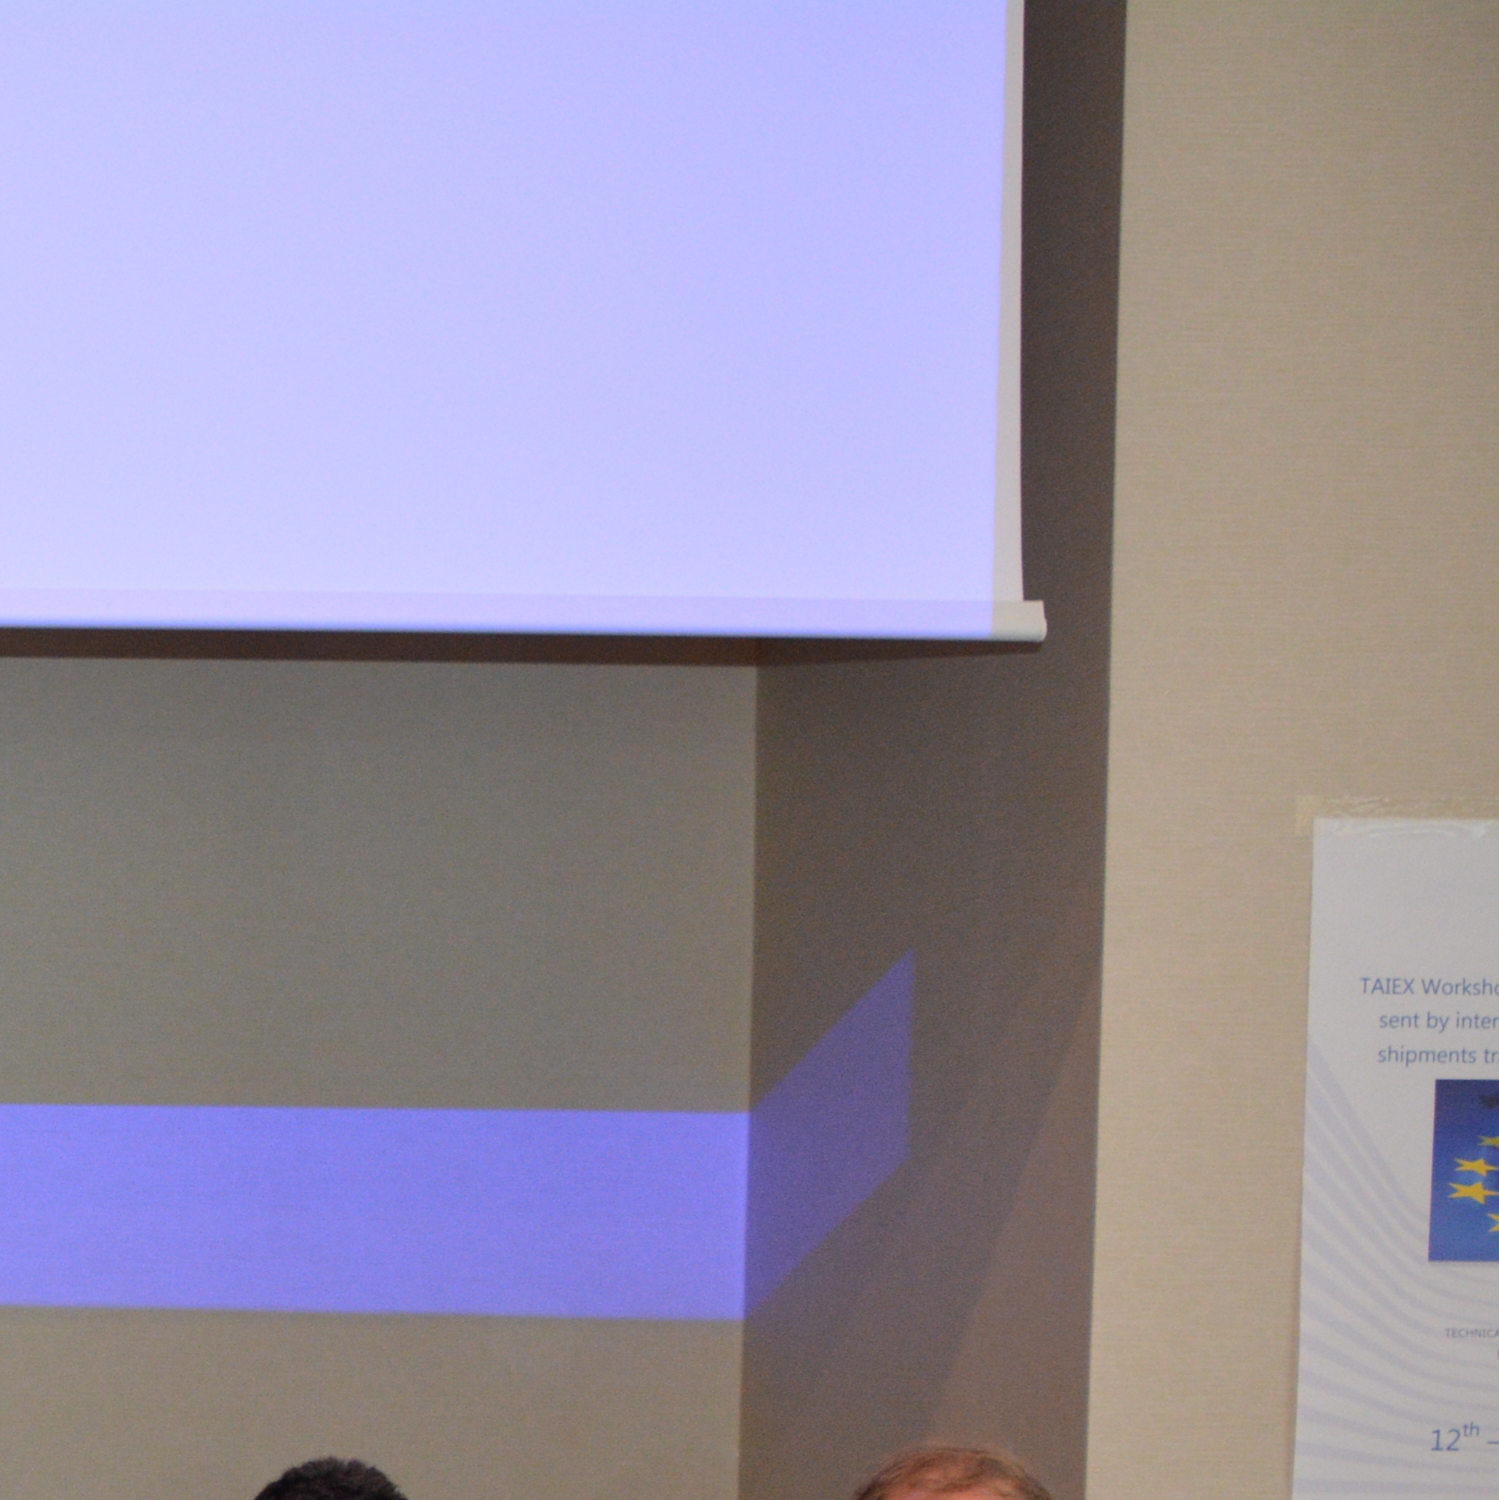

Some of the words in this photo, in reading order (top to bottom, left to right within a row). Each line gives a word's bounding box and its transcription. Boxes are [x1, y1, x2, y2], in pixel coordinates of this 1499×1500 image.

[1360, 977, 1415, 995] TAIEX
[1379, 1013, 1419, 1028] sent
[1427, 1011, 1450, 1034] by
[1378, 1045, 1477, 1067] shipments
[1484, 1049, 1499, 1064] tr
